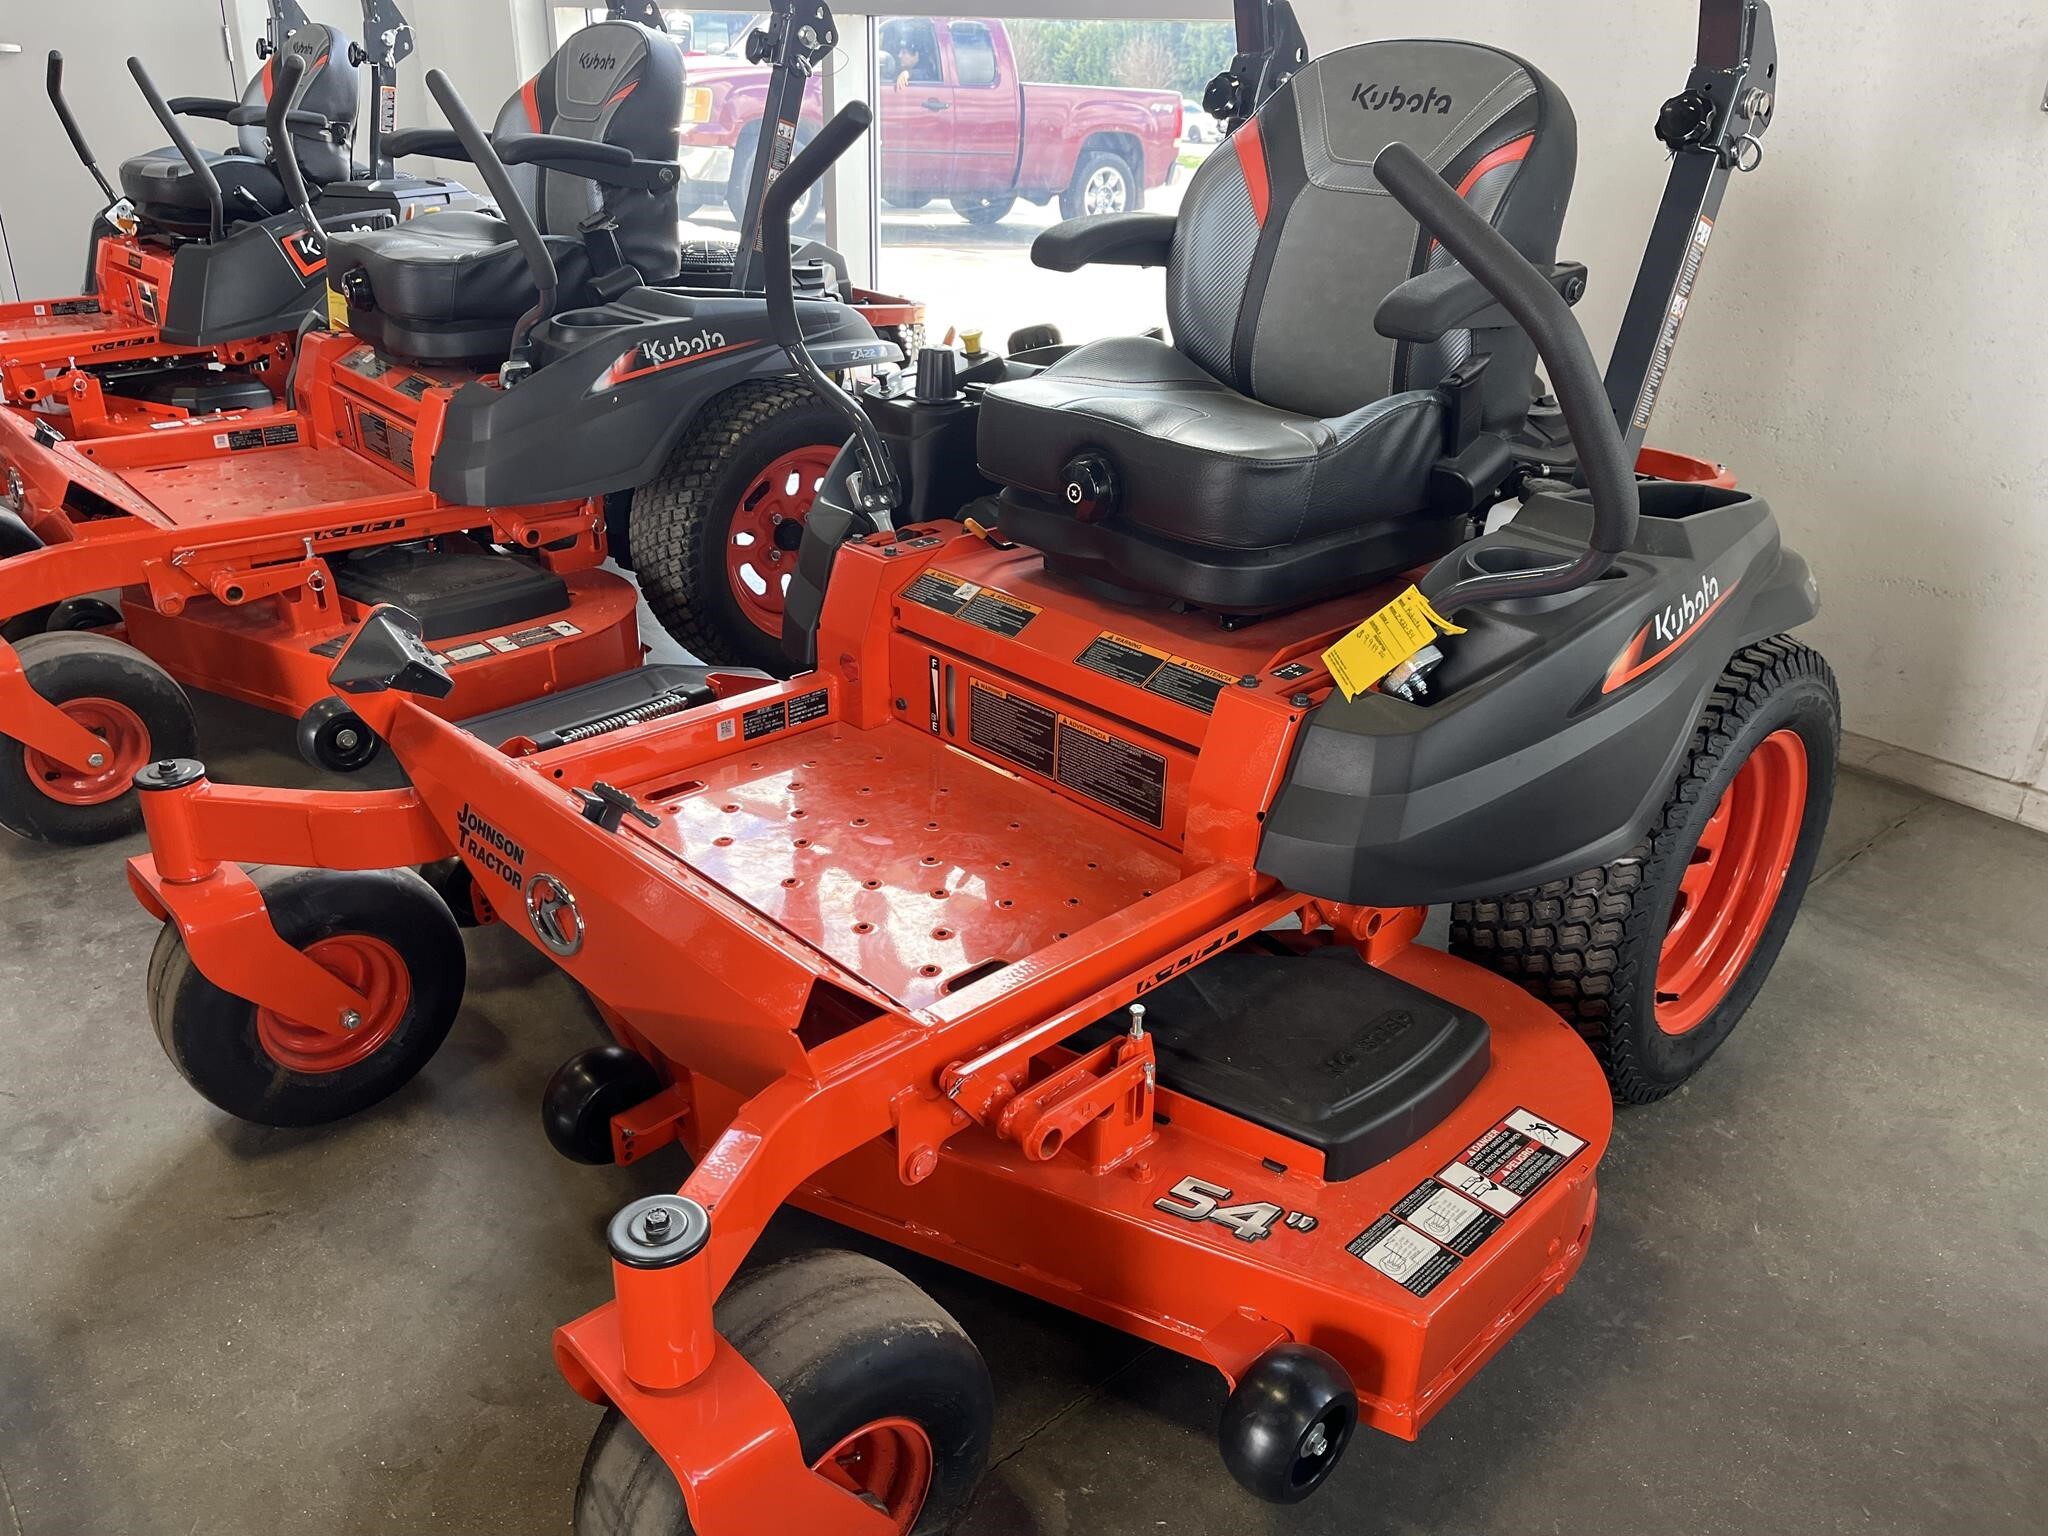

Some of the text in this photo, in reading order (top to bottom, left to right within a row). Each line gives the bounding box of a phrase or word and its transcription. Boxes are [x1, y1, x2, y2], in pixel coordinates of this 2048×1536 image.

[579, 52, 615, 70] Kubota
[1351, 83, 1452, 114] Kubota
[642, 328, 725, 361] Kubota
[314, 518, 406, 541] K-LIFT
[1655, 575, 1719, 641] Kubota
[1115, 636, 1142, 650] WARNING
[931, 658, 938, 668] F
[1188, 662, 1233, 682] ADVERTENCIA
[932, 722, 938, 732] E
[1069, 720, 1107, 741] ADVERTENCIA
[457, 802, 525, 865] JOHNSON
[458, 825, 523, 890] TRACTOR
[1137, 929, 1239, 994] K-LIFT
[1466, 1132, 1511, 1169] DO NOT PUT HANDS OR
[1470, 1129, 1500, 1154] DANGER
[1475, 1133, 1522, 1173] FEET INTO MOWER WHEN
[1483, 1163, 1501, 1178] ENGINE
[1507, 1147, 1535, 1173] PELIGRO
